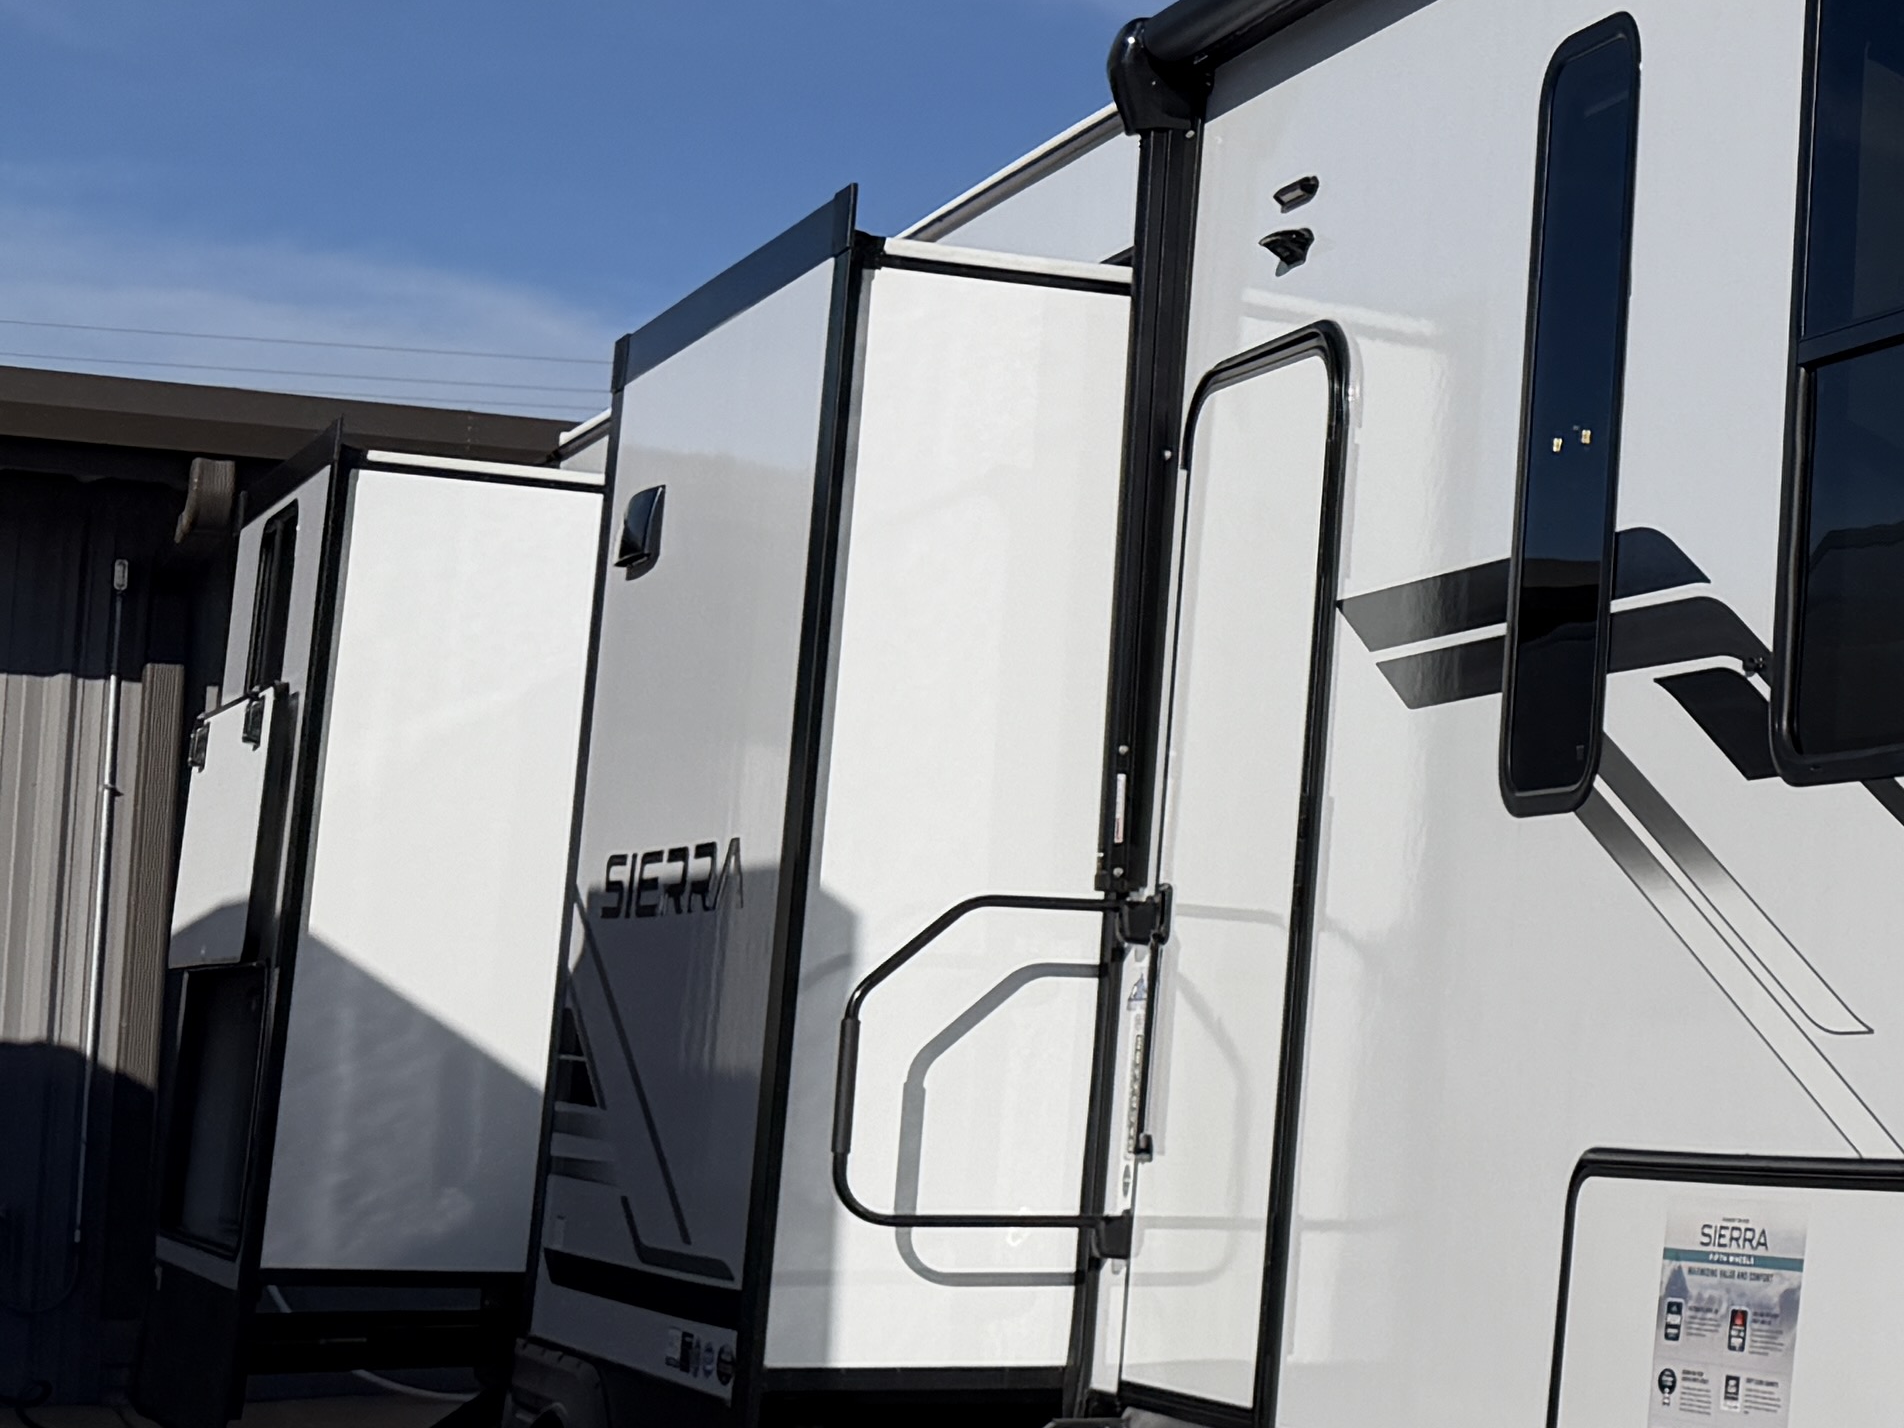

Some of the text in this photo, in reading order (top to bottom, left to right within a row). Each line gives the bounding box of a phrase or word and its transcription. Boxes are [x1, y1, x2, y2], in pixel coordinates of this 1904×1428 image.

[600, 837, 744, 919] SIERRA
[1699, 1223, 1769, 1251] SIERRA
[1728, 1255, 1754, 1265] WHEELS
[1737, 1271, 1748, 1281] AND
